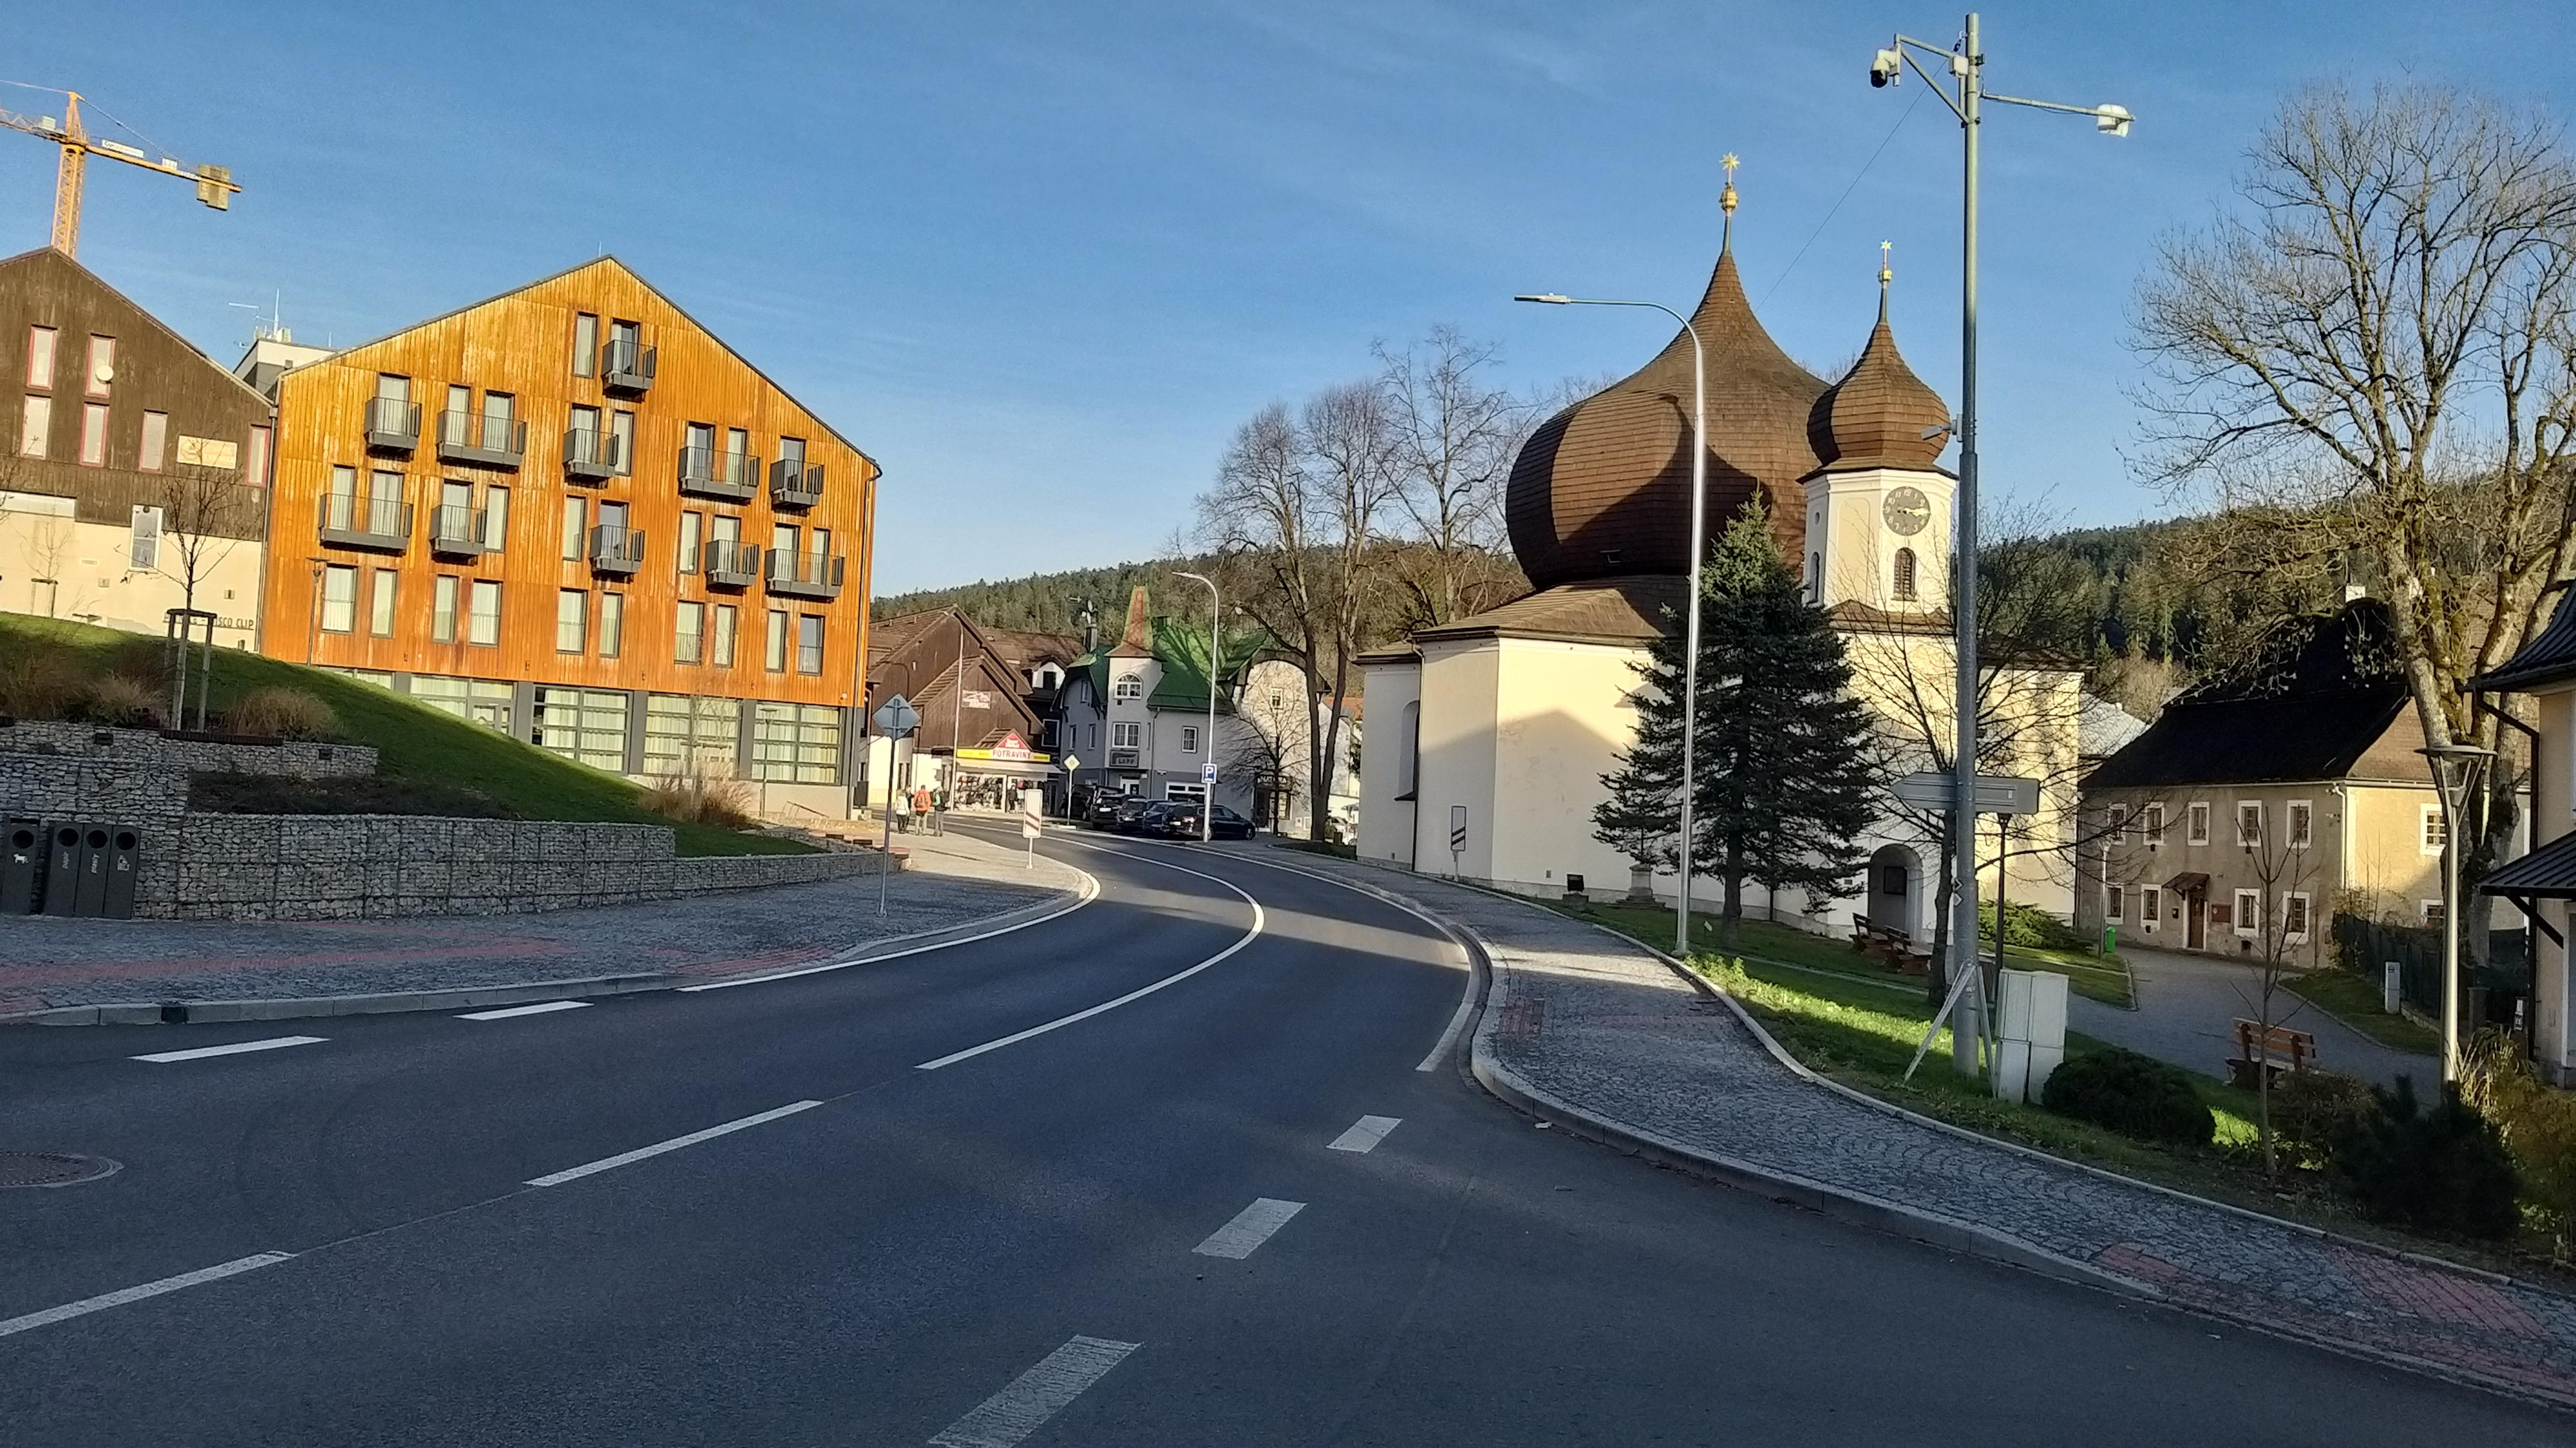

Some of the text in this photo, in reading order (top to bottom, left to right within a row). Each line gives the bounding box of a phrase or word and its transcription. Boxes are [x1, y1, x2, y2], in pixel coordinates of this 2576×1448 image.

[1920, 499, 1926, 507] 2
[1888, 515, 1894, 524] 8
[1895, 522, 1899, 531] 7
[210, 616, 232, 627] ISCO
[236, 618, 254, 629] CLIP
[992, 749, 1031, 759] POTRAVINY
[1205, 766, 1214, 777] P
